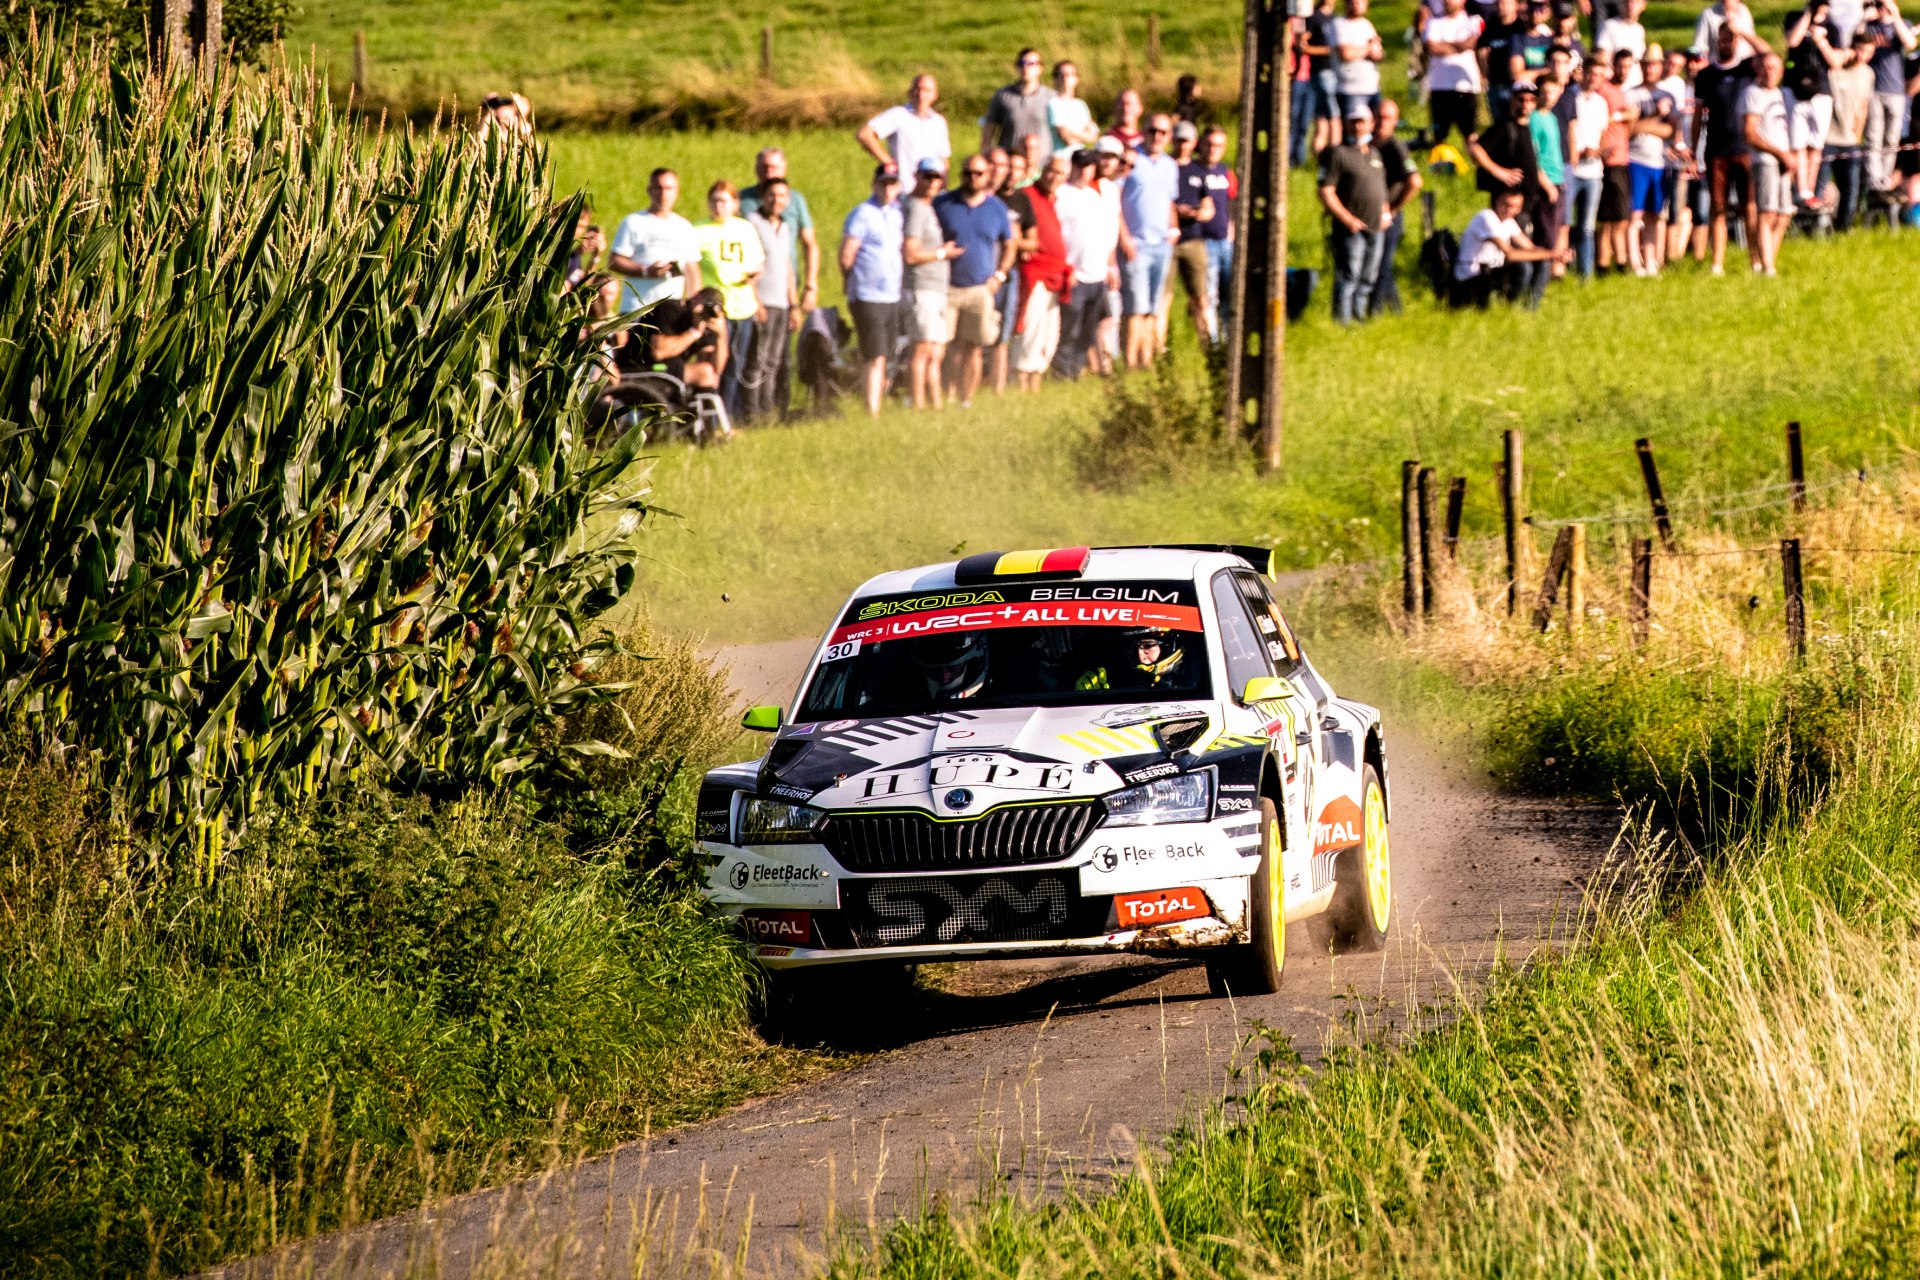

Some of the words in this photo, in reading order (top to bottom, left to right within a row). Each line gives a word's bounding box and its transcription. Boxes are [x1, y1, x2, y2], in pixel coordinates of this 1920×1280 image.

[858, 590, 1005, 621] ŠKODA
[1030, 587, 1180, 603] BELGIUM
[847, 629, 873, 640] WRC
[875, 627, 884, 635] 3
[1021, 608, 1070, 622] ALL
[1077, 608, 1134, 622] LIVE
[827, 642, 853, 660] 30
[752, 864, 820, 880] FleetBack
[1124, 896, 1196, 918] TOTAL
[747, 917, 803, 935] TOTAL
